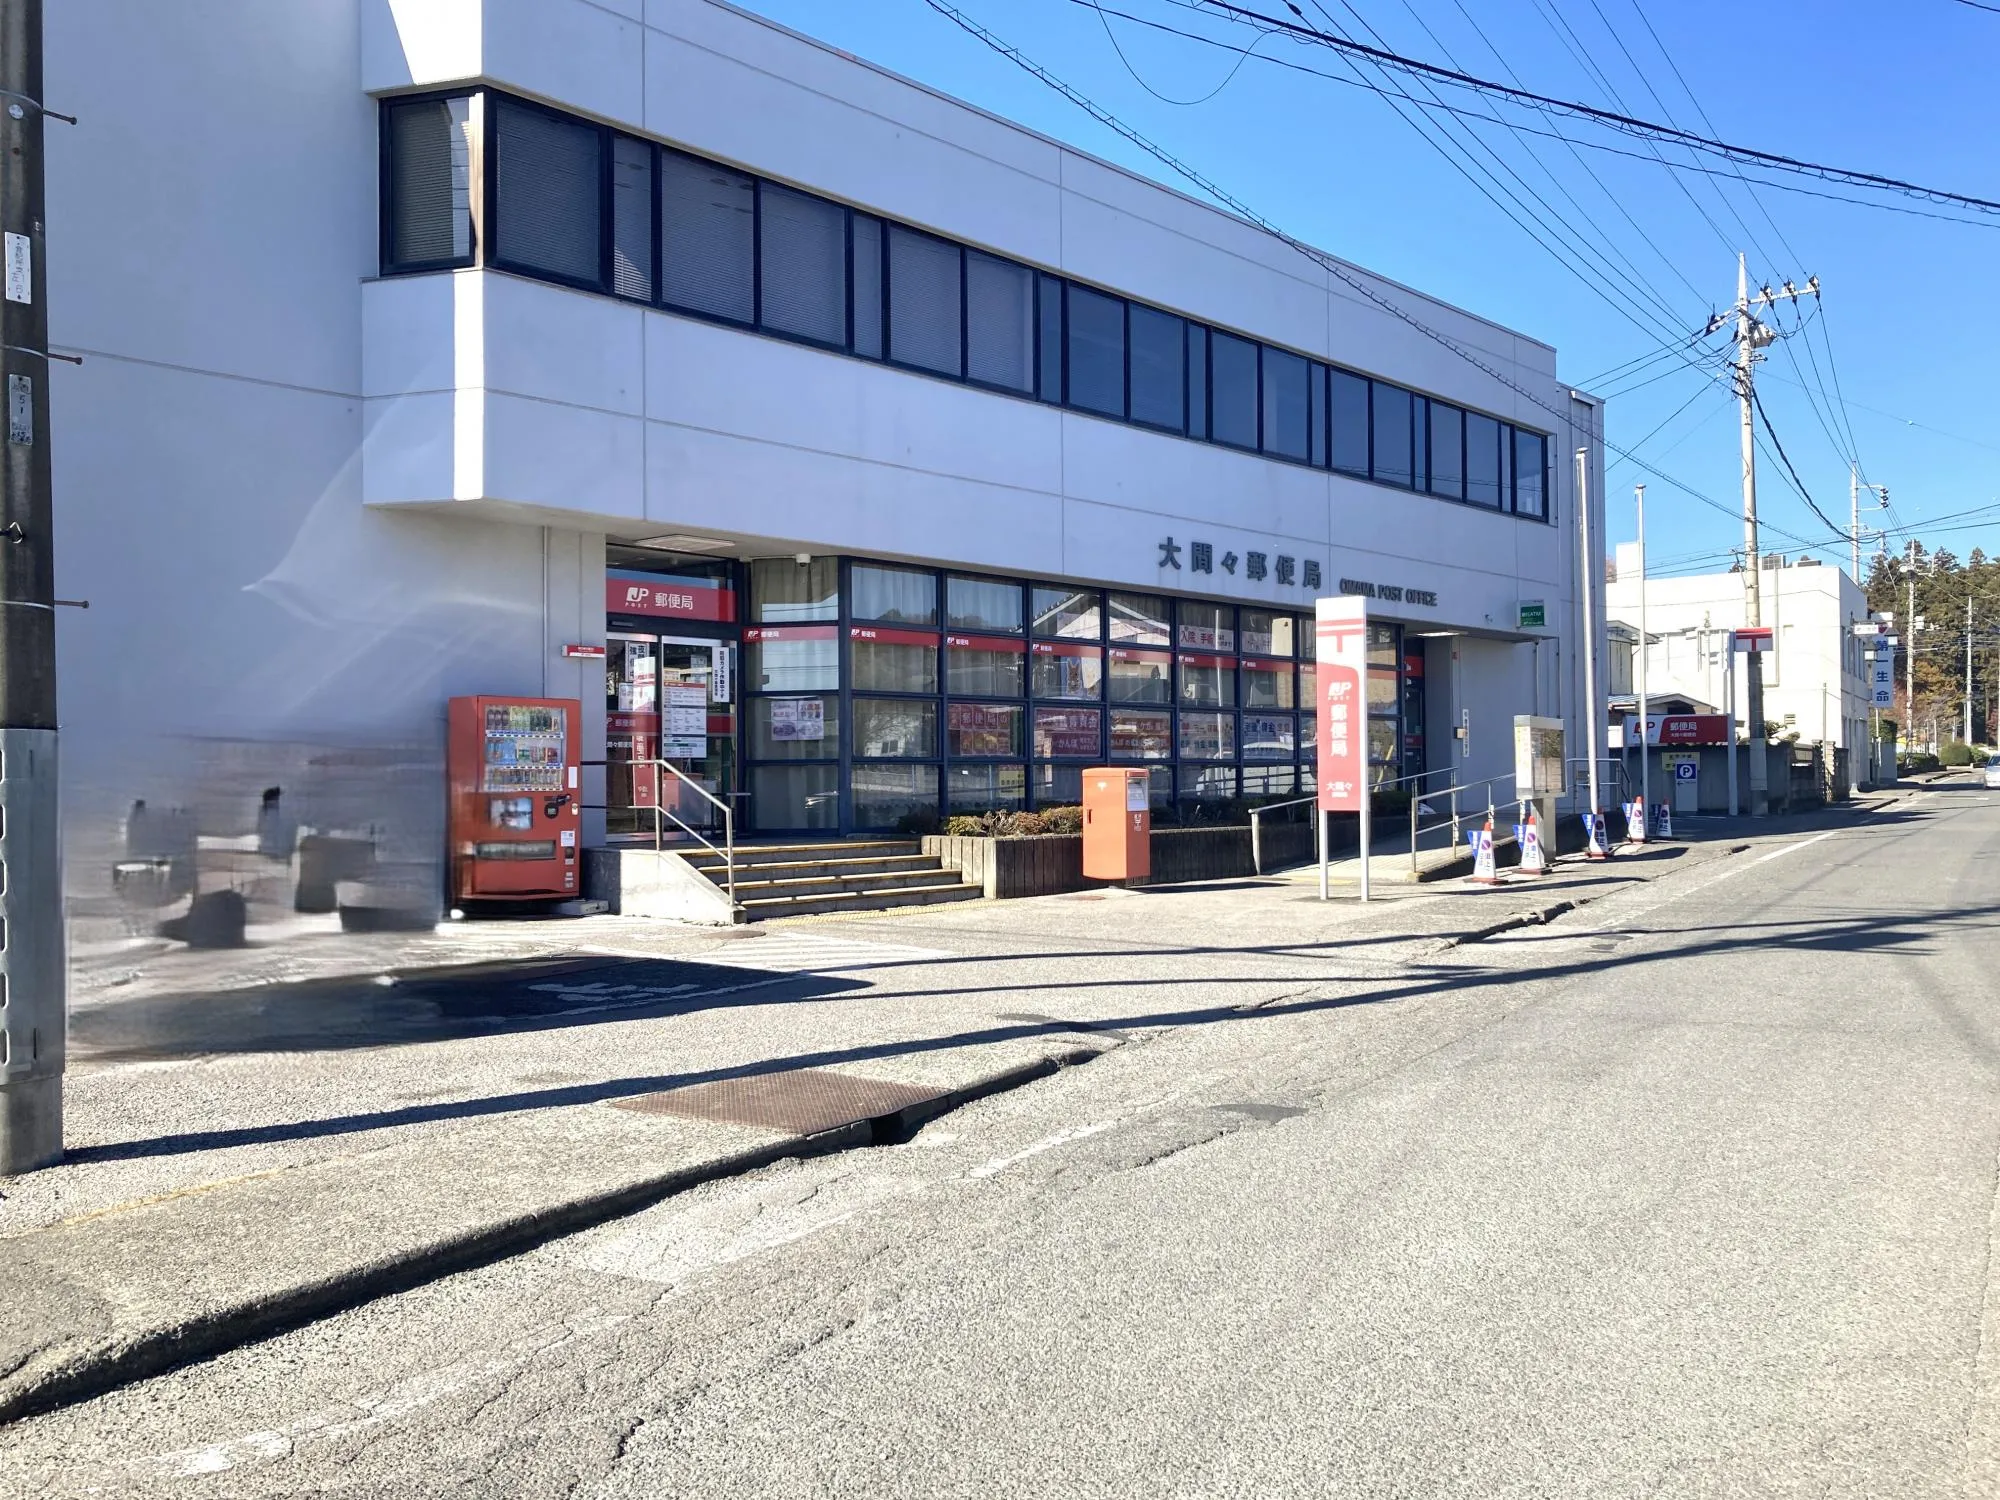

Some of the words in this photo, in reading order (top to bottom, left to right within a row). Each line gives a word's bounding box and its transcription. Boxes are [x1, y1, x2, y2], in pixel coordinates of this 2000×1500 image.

[1158, 536, 1322, 590] 大間々郵便局
[626, 587, 649, 602] JP
[655, 592, 694, 610] 郵便局
[1377, 584, 1403, 602] POST
[1405, 588, 1438, 607] OFFICE
[1876, 640, 1889, 702] 第一生命
[1330, 703, 1348, 758] 郵便局
[1670, 722, 1697, 731] 郵便局
[1683, 766, 1690, 777] P
